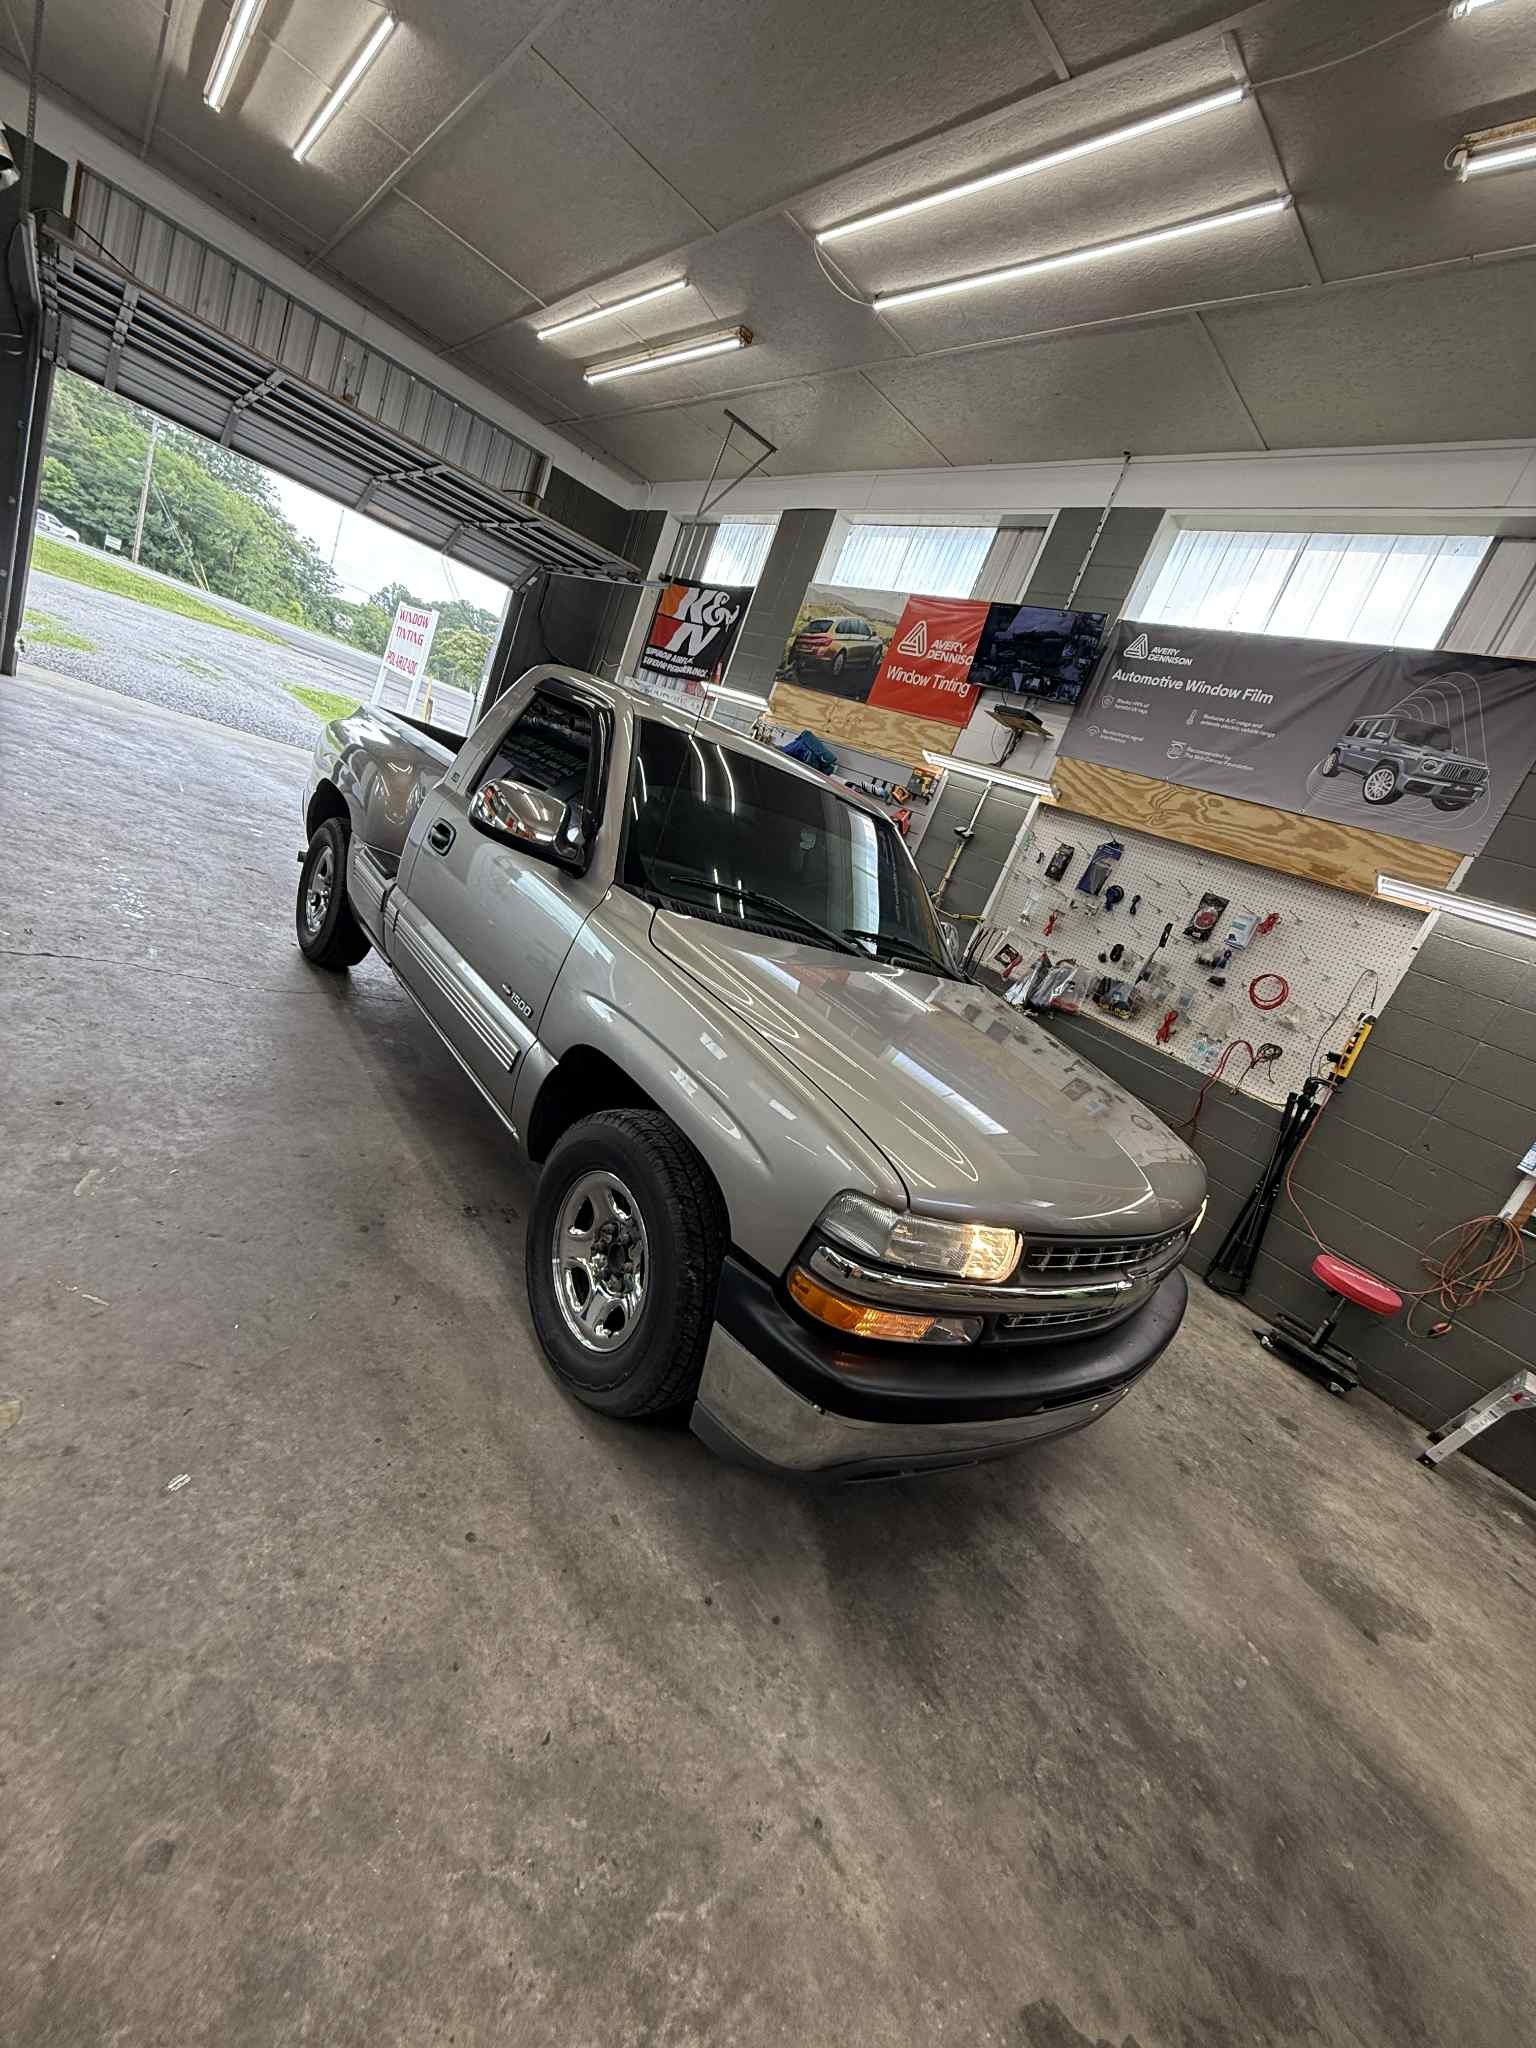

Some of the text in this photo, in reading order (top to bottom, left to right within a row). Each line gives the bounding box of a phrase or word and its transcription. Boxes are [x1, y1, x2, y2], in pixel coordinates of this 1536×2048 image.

[399, 609, 430, 629] WINDOW
[396, 626, 425, 646] TINTING
[930, 639, 968, 653] AVERY
[927, 649, 974, 666] DENNISO
[1147, 654, 1193, 666] DENNISON
[1151, 646, 1180, 656] AVERY
[886, 665, 971, 698] Window Tinting
[1112, 669, 1274, 705] Automotive Window Film
[511, 992, 532, 1017] 1500
